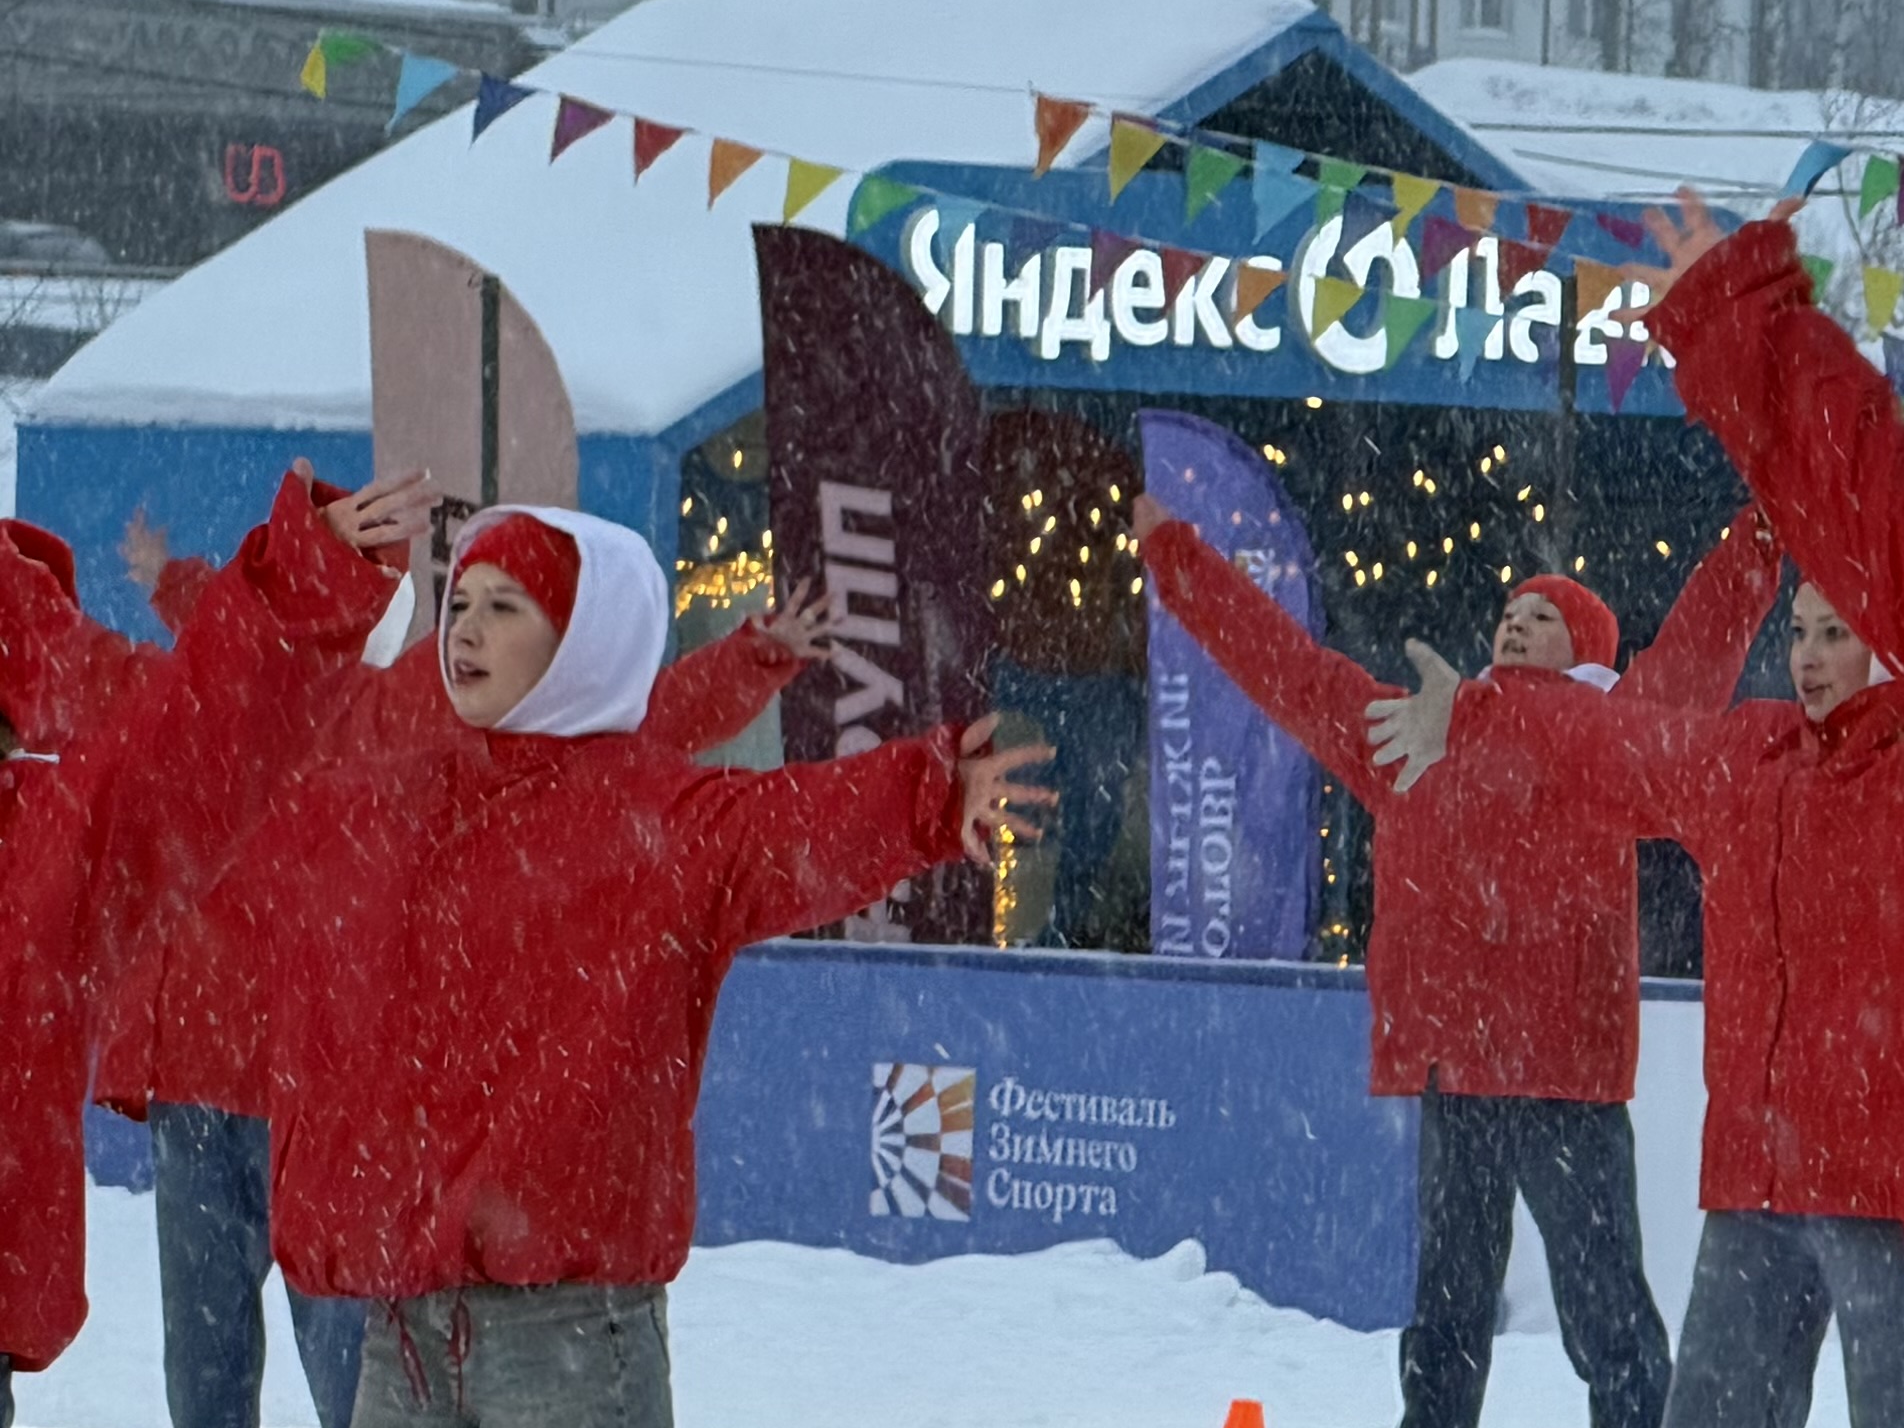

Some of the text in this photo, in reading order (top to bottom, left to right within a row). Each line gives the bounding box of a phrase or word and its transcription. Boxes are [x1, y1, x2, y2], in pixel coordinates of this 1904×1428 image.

[908, 207, 1284, 362] Яндекс
[988, 1075, 1177, 1128] Фестиваль
[988, 1121, 1138, 1172] Зимнего
[987, 1167, 1118, 1223] Спорта
